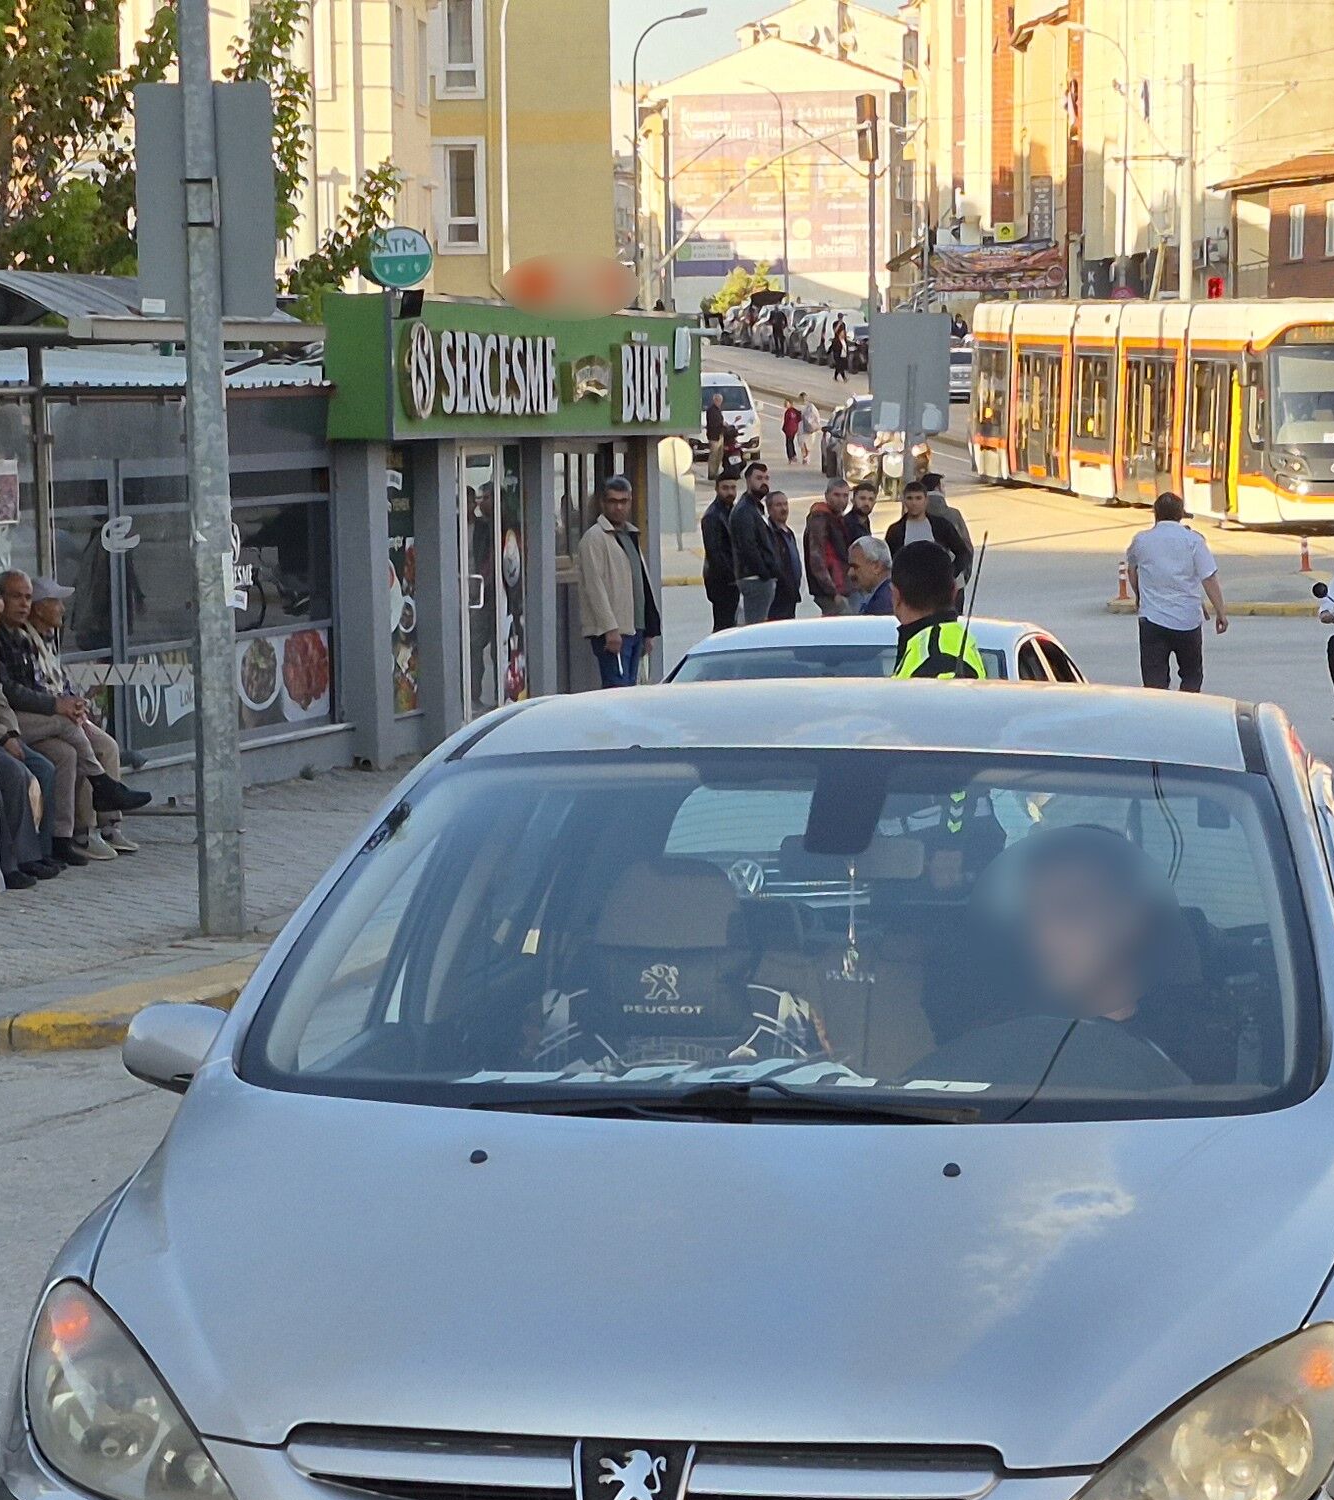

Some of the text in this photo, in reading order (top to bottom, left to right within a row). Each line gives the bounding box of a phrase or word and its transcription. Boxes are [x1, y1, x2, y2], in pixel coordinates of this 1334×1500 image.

[441, 330, 559, 416] SERCESME
[621, 331, 671, 423] BÜFE
[623, 1004, 703, 1014] PEUGEOT
